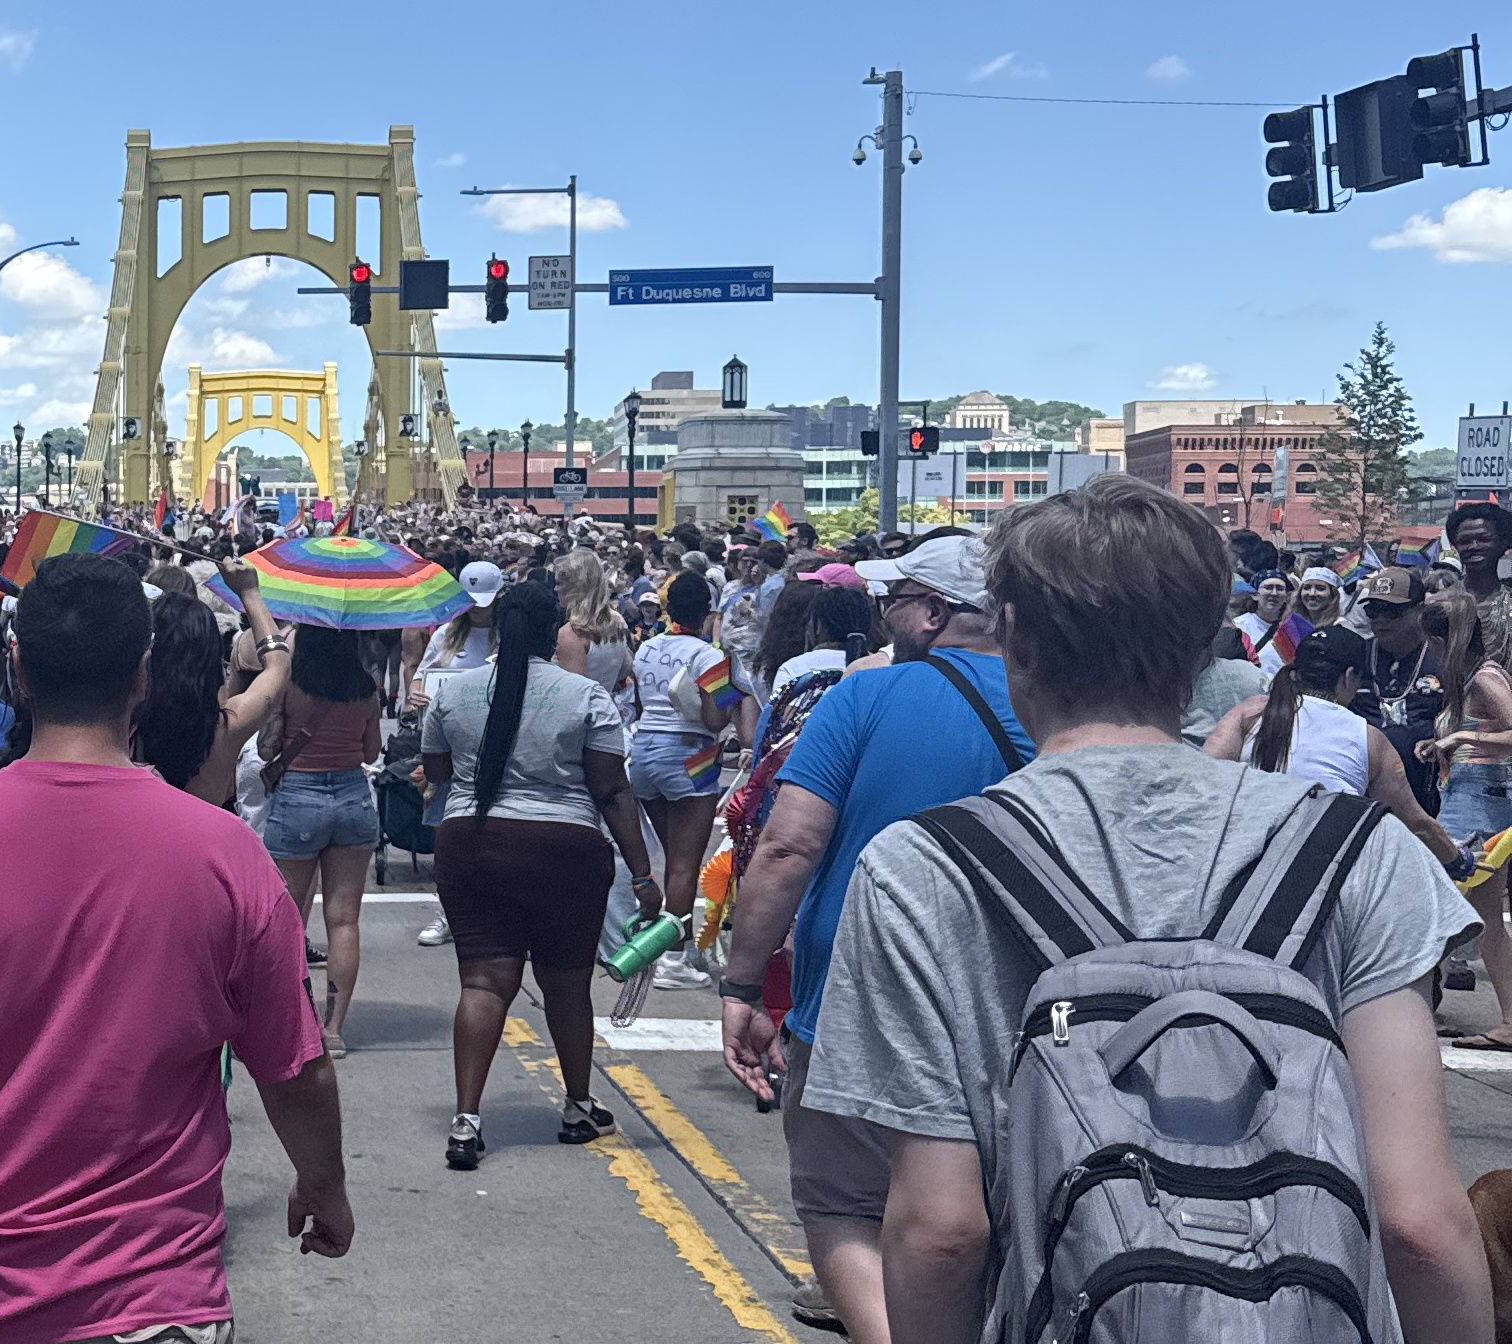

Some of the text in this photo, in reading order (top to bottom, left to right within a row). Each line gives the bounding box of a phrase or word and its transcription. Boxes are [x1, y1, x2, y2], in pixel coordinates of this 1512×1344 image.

[542, 259, 560, 268] NO
[535, 270, 567, 279] TURN
[752, 271, 771, 279] 600
[531, 281, 571, 291] ON RED
[617, 283, 766, 302] Ft Duquesne Blvd
[1468, 427, 1500, 448] ROAD
[994, 441, 1041, 452] Wabtec
[1461, 456, 1505, 477] CLOSED
